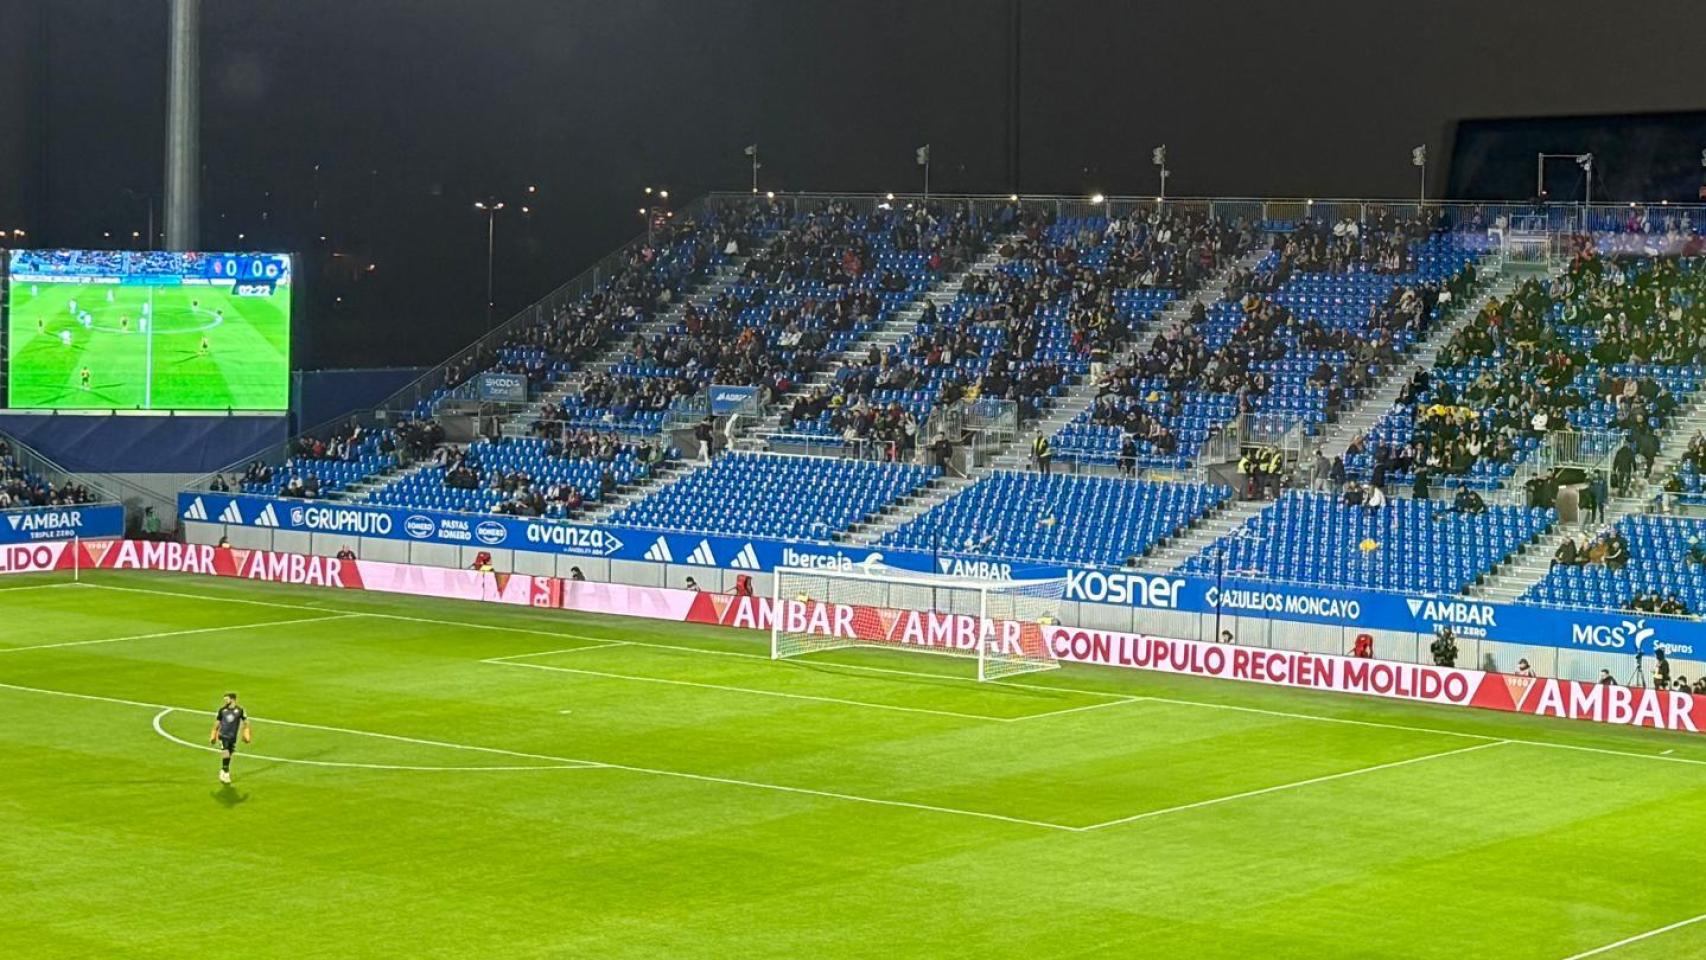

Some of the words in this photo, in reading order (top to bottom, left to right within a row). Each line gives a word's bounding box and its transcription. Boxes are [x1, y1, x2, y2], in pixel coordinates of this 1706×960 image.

[226, 260, 237, 277] 0
[252, 260, 263, 277] 0
[21, 511, 83, 531] AMBAR
[305, 507, 392, 535] GRUPAUTO
[407, 522, 433, 531] ROMERO
[441, 519, 469, 530] PASTAS
[30, 531, 54, 539] TRIPLE
[56, 529, 75, 537] ZERO
[438, 529, 472, 541] ROMERO
[526, 523, 604, 548] avanza
[113, 540, 218, 575] AMBAR
[248, 550, 345, 588] AMBAR
[782, 548, 853, 573] Ibercaja
[953, 559, 1013, 581] AMBAR
[1221, 589, 1282, 612] AZULEJOS
[1285, 595, 1360, 620] MONCAYO
[1423, 600, 1497, 627] AMBAR
[733, 596, 858, 639] AMBAR
[1433, 622, 1461, 635] TRLE
[1463, 626, 1487, 638] ZERO
[901, 611, 1025, 656] AMBAR
[1572, 623, 1625, 648] MGS
[1652, 639, 1693, 655] Seguros
[1051, 629, 1111, 663] CON
[1342, 660, 1468, 703] MOLIDO
[1535, 678, 1699, 732] AMBAR
